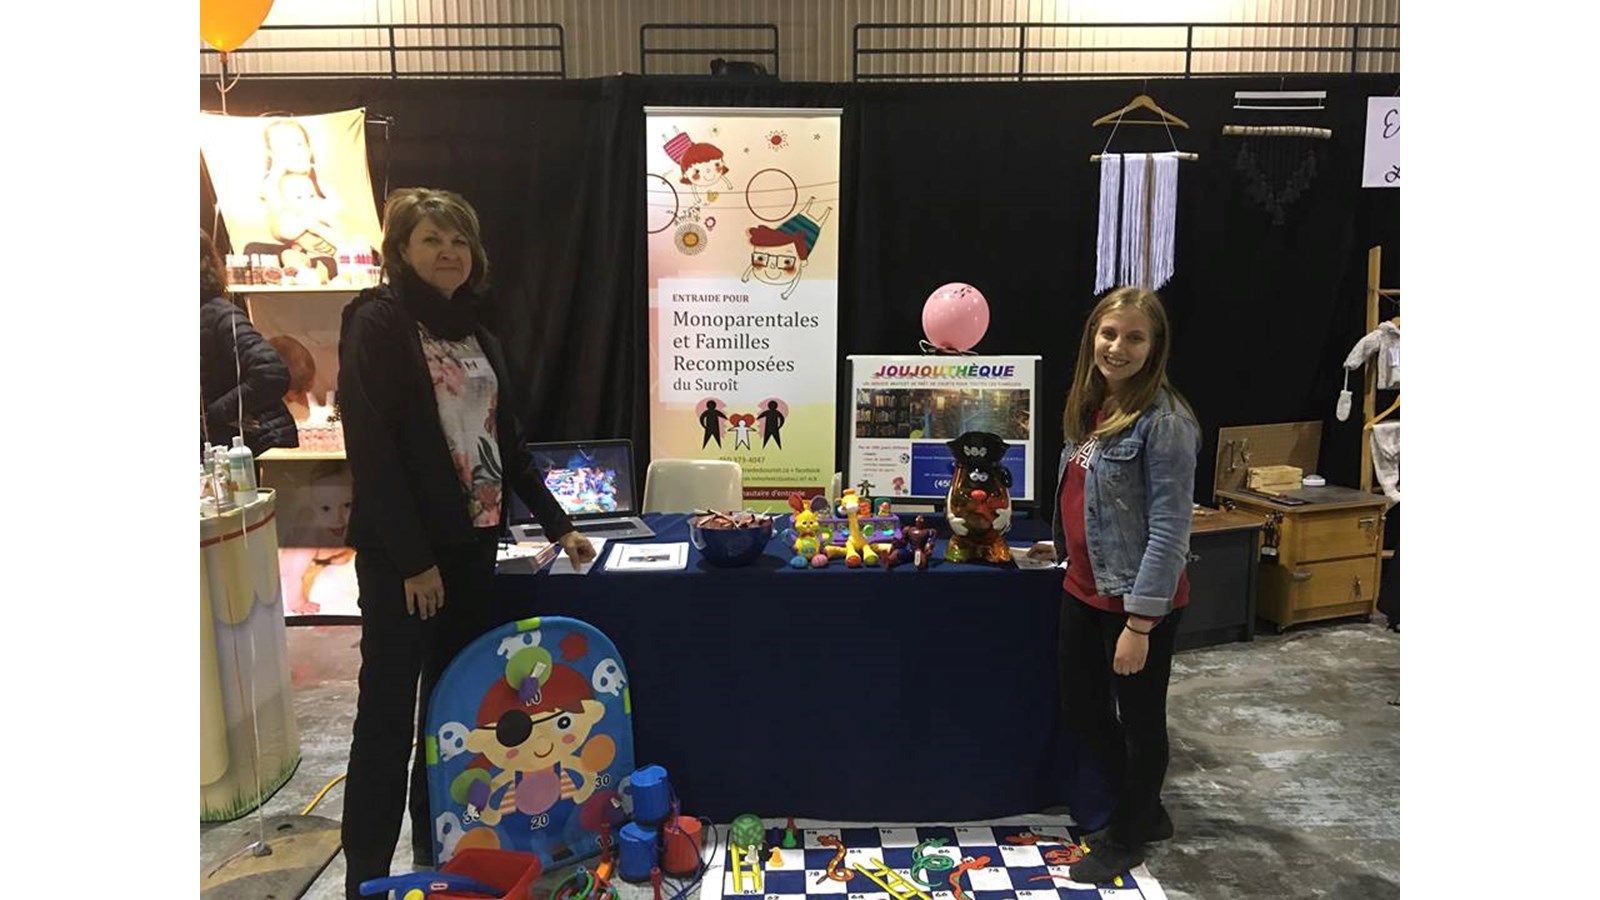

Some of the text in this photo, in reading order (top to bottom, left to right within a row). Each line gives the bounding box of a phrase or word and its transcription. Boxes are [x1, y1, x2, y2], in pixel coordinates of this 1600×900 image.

[672, 294, 749, 303] ENTRAIDE POUR
[673, 310, 819, 331] Monoparentales
[673, 333, 770, 349] et Familles
[673, 355, 795, 376] Recomposées
[875, 362, 1015, 378] JOUJOUTHÈQUE
[673, 377, 739, 391] du Suroît
[595, 774, 611, 788] 30
[530, 812, 549, 830] 20
